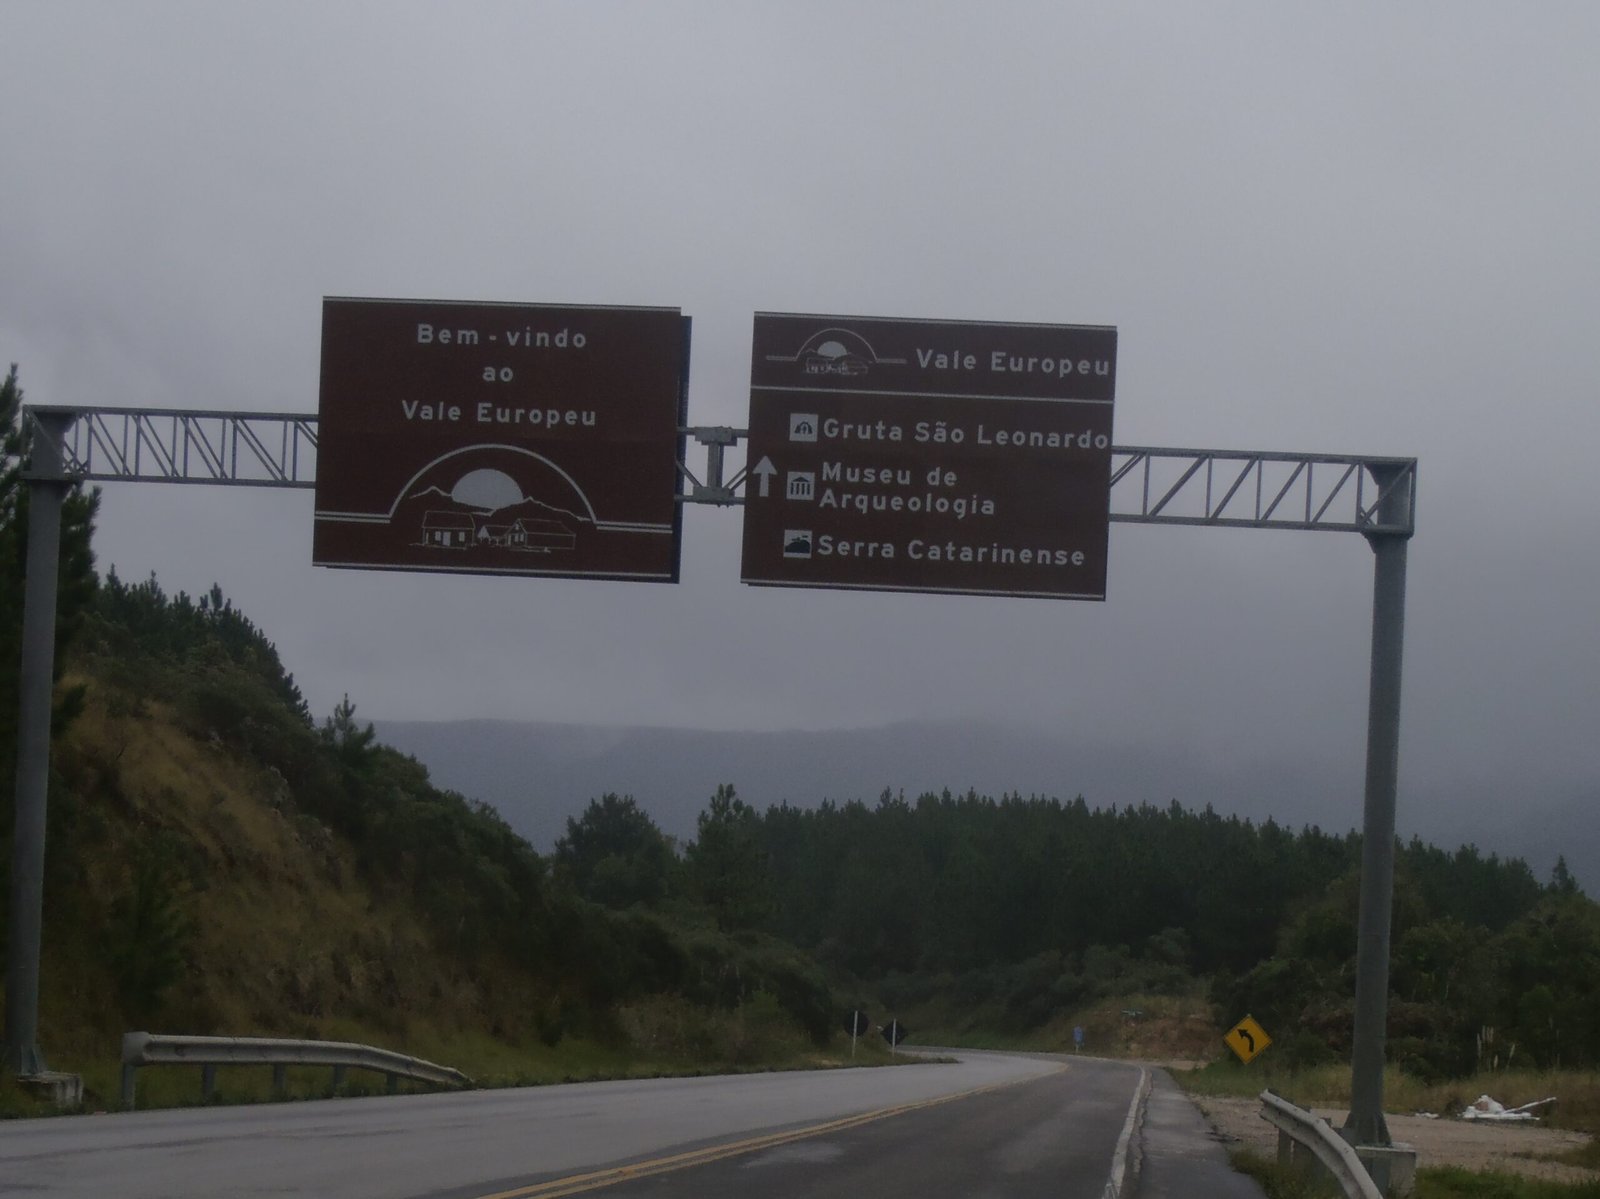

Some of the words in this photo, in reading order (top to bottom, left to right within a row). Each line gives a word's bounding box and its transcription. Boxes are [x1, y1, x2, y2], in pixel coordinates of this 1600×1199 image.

[482, 366, 514, 382] ao
[916, 348, 977, 370] Vale
[991, 352, 1109, 378] Europeu
[402, 400, 461, 421] Vale
[477, 402, 596, 429] Europeu
[823, 419, 902, 440] Gruta
[914, 421, 964, 443] São
[978, 424, 1108, 449] Leonardo
[822, 462, 911, 484] Museu
[926, 467, 958, 487] de
[819, 489, 995, 519] Arqueologia
[818, 535, 894, 558] Serra
[908, 540, 1085, 566] Catarinense
